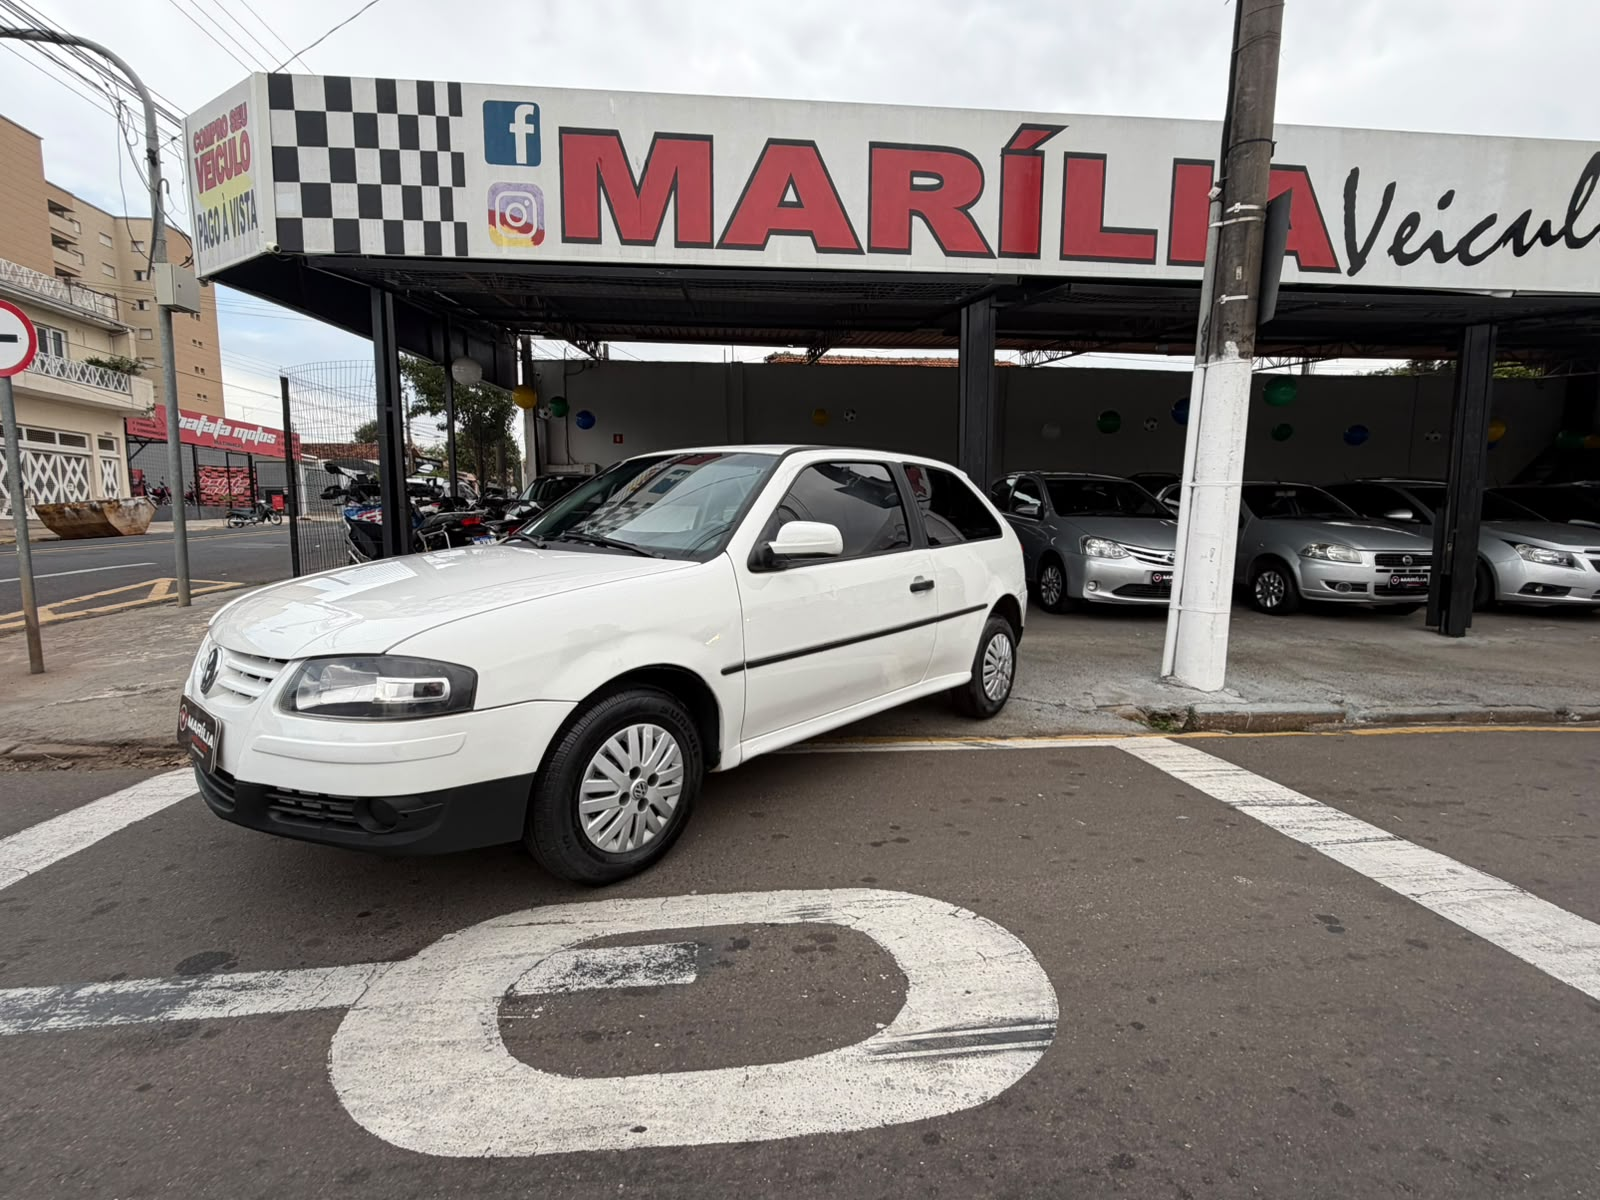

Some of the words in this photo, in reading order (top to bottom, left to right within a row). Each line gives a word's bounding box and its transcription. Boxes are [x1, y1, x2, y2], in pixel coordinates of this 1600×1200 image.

[193, 114, 228, 154] COMPRO
[229, 101, 248, 133] SEU
[197, 206, 220, 252] PAGO
[229, 189, 258, 238] VISTA
[187, 715, 214, 749] MARÍLIA
